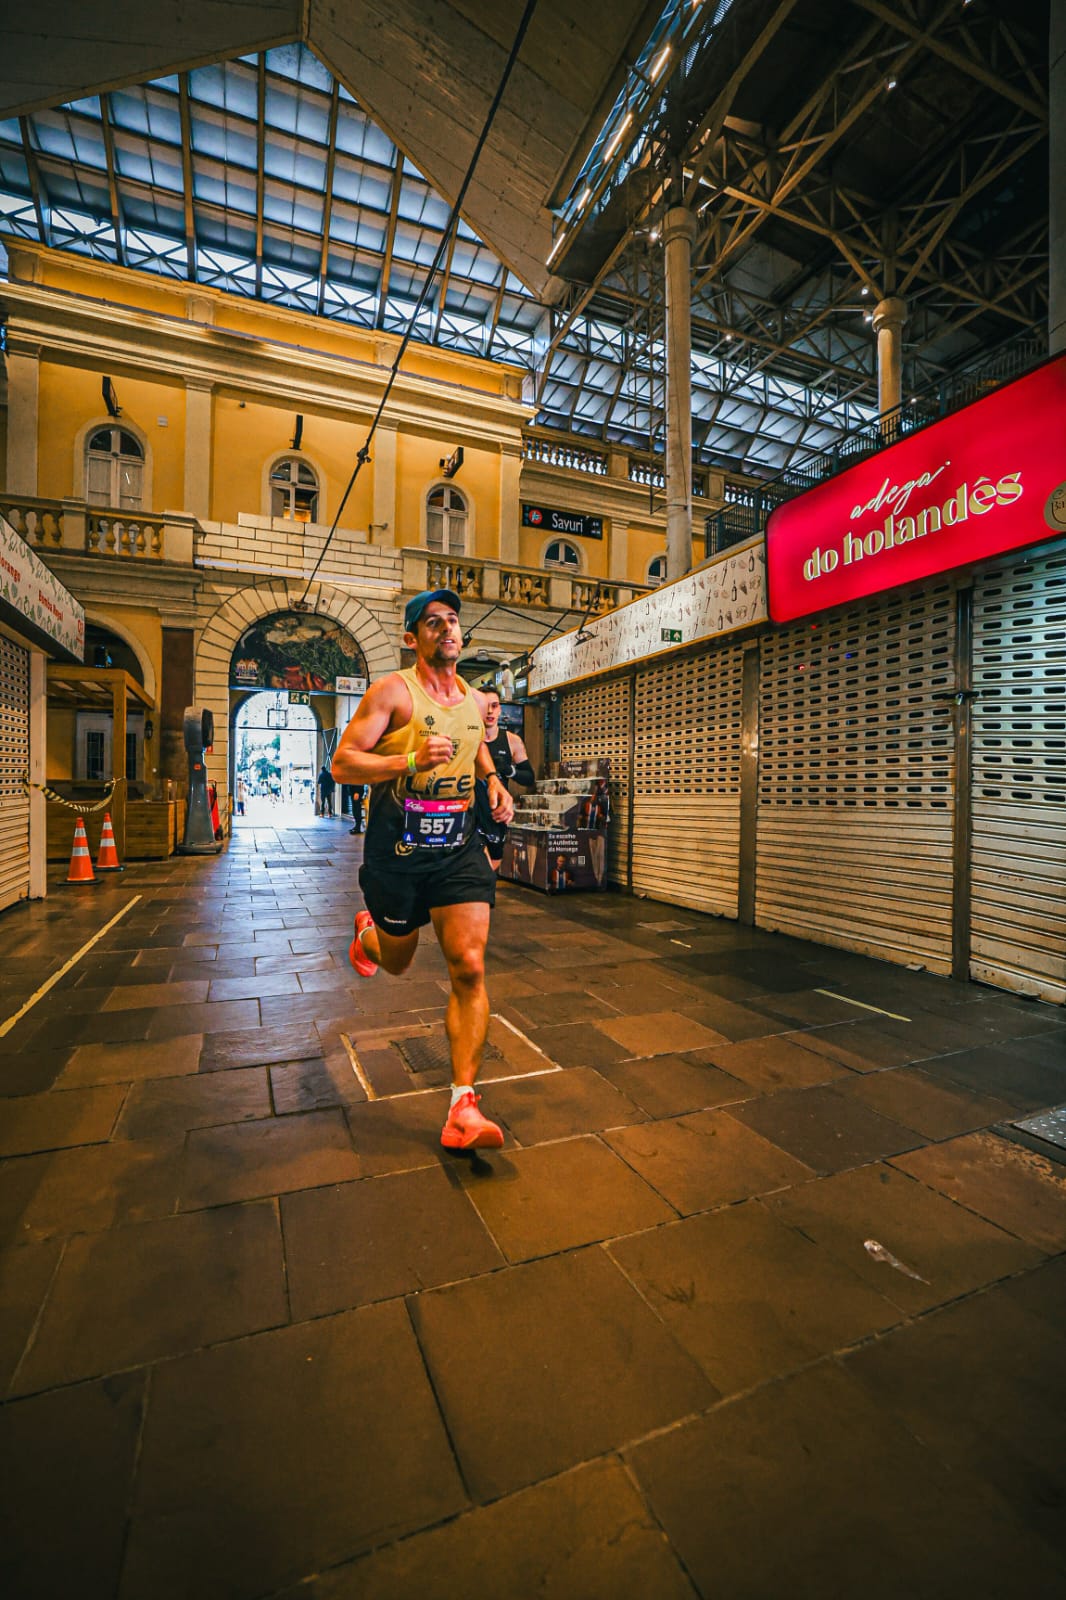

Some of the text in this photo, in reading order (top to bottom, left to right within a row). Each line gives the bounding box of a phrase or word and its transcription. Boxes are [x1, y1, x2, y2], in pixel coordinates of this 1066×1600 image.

[850, 461, 951, 520] adega
[552, 513, 583, 533] Sayuri
[803, 471, 1024, 581] do holandês
[419, 818, 455, 835] 557
